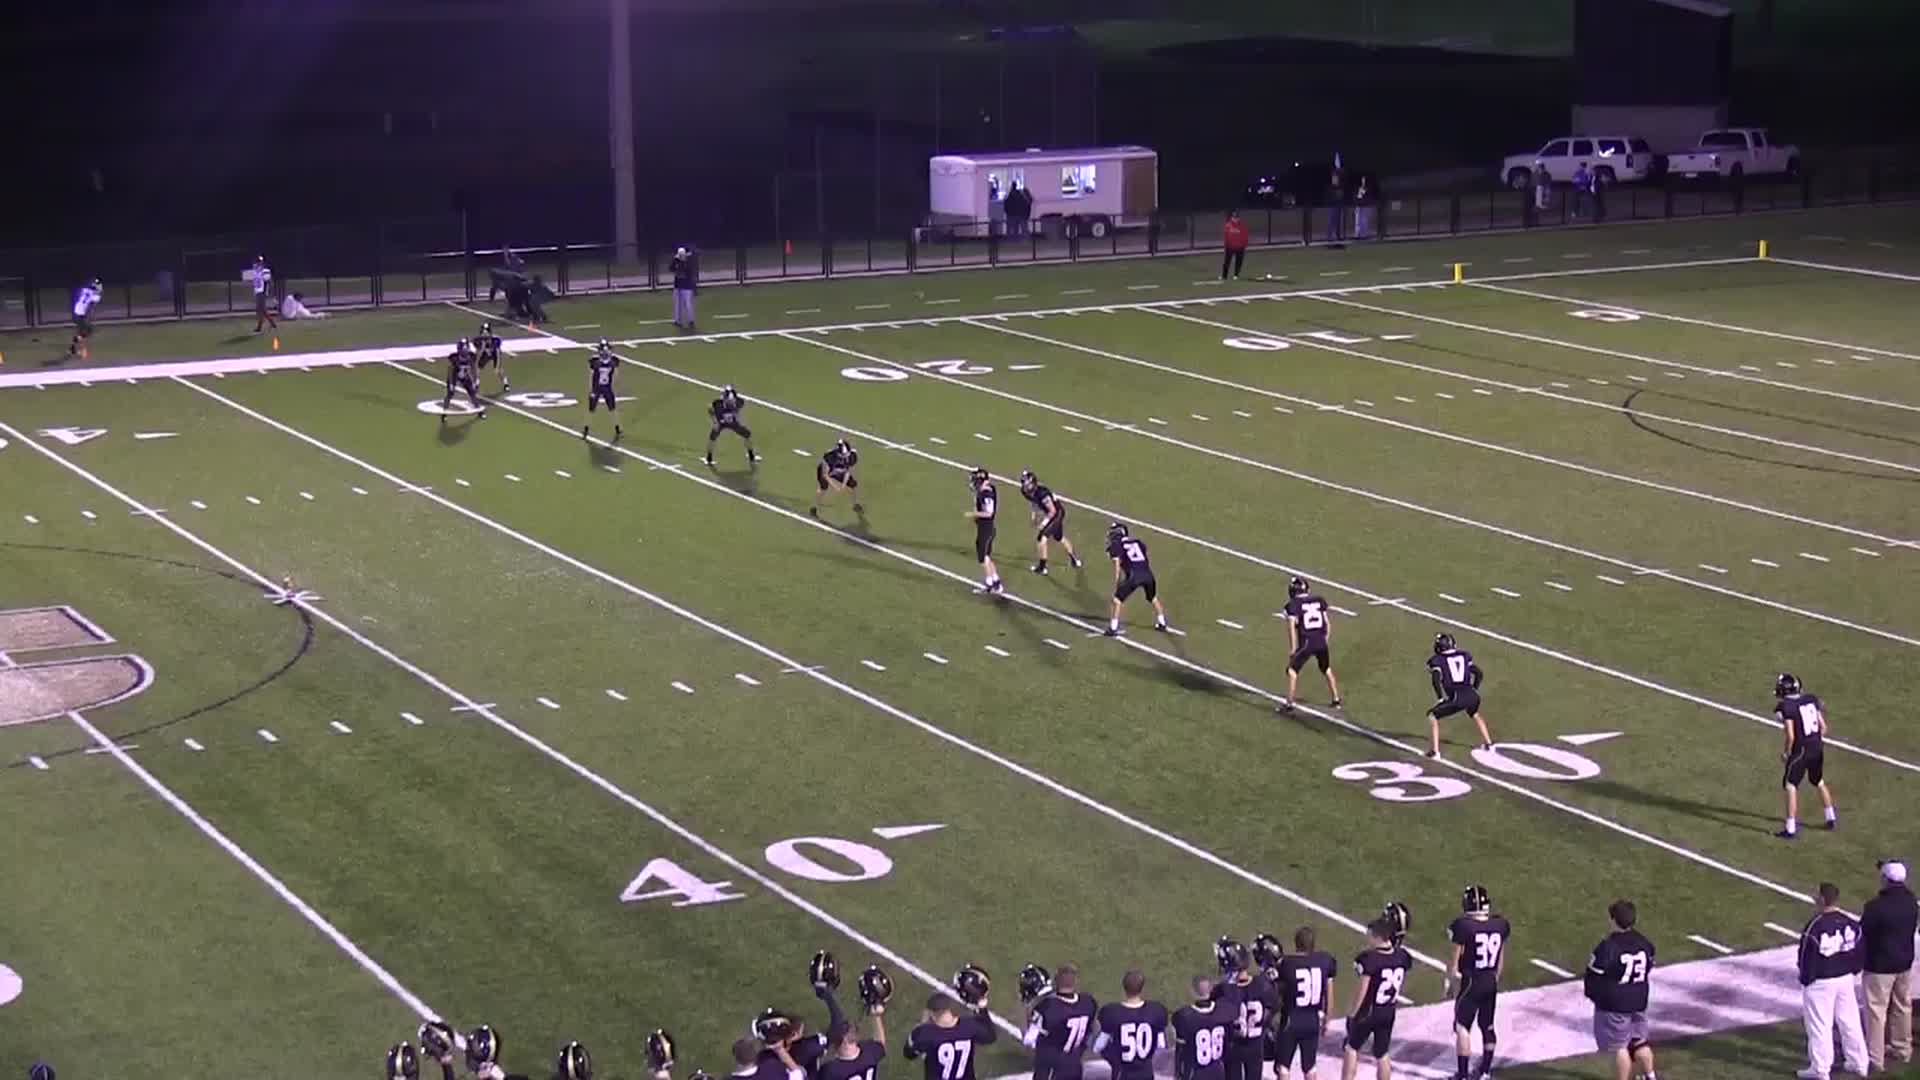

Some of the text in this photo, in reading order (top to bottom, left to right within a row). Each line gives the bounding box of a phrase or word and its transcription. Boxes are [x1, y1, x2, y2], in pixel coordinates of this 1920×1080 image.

[1222, 331, 1373, 351] 10
[841, 360, 994, 381] 20
[1331, 743, 1600, 801] 30
[619, 837, 893, 907] 40
[1474, 932, 1501, 969] 39
[1619, 950, 1647, 985] 73
[1295, 966, 1322, 1007] 31
[1375, 967, 1405, 1005] 29
[937, 1039, 972, 1080] 97
[1120, 1022, 1153, 1062] 50
